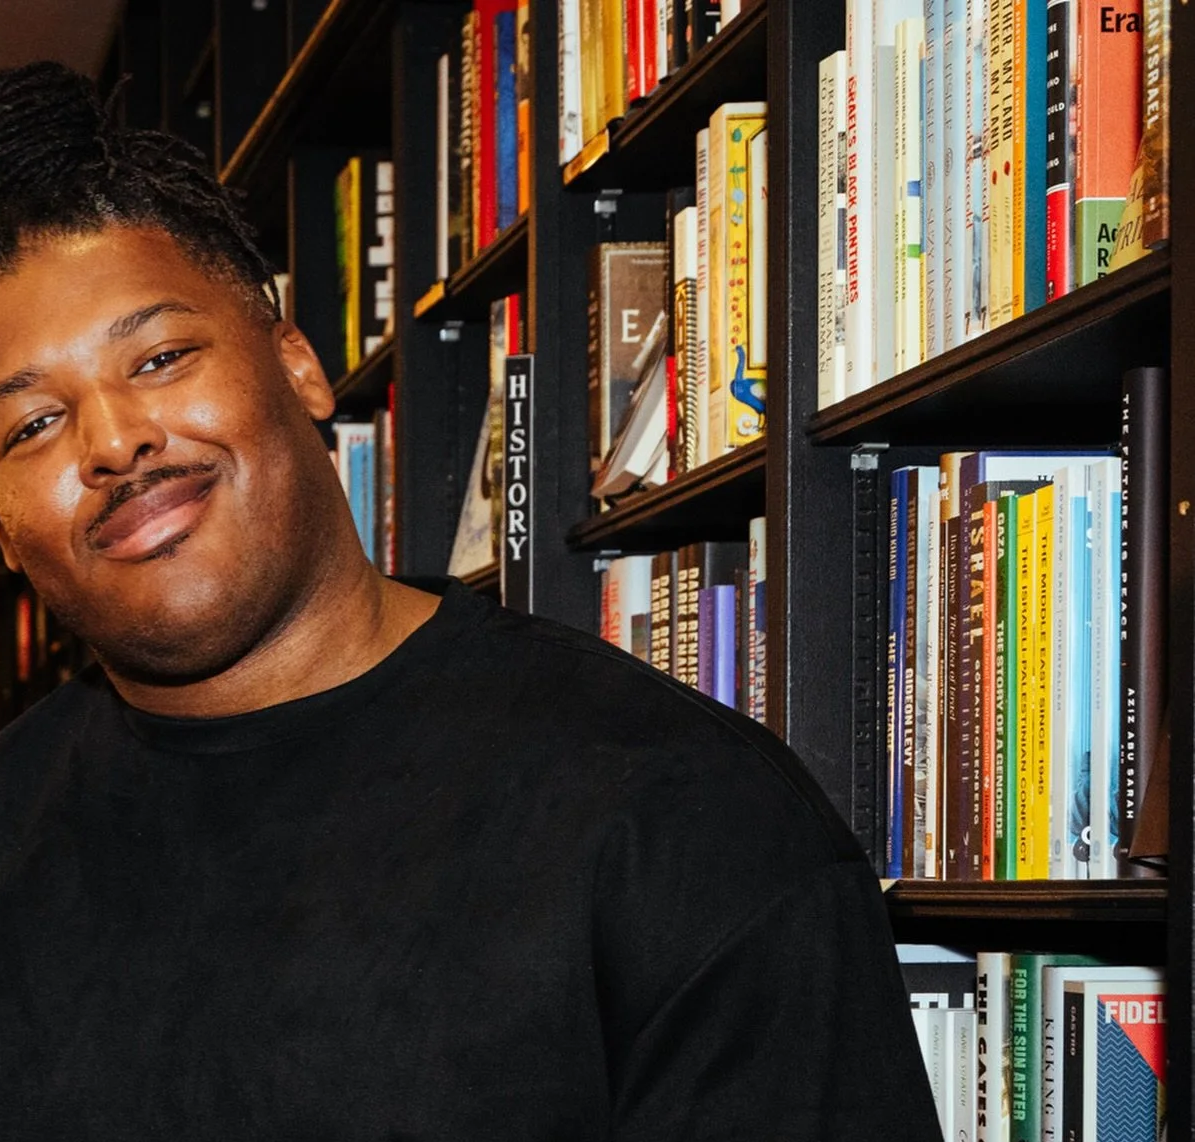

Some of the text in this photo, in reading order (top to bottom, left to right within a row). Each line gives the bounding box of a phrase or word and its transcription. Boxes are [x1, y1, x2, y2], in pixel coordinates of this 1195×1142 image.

[848, 76, 859, 149] ISRAEL'S
[990, 69, 999, 152] MY LAND
[1002, 58, 1012, 143] MY LAND
[1144, 45, 1160, 130] ISRAEL
[848, 152, 859, 208] BLACK
[848, 214, 859, 304] PANTHERS
[508, 374, 527, 561] HISTORY
[1121, 393, 1129, 641] THE FUTURE IS PEACE
[970, 508, 984, 645] ISRAEL
[996, 620, 1005, 652] THE
[1038, 533, 1047, 795] THE MIDDLE EAST SINCE 1945
[904, 668, 913, 766] GIDEON LEVY
[996, 655, 1005, 712] STORY
[996, 714, 1005, 736] OF
[1020, 544, 1028, 865] THE ISRAELI-PALESTINIAN CONFLICT
[996, 752, 1005, 838] GENOCIDE
[1126, 687, 1135, 820] AZIZ ABU SARAH
[977, 973, 987, 1026] THE
[1105, 1001, 1165, 1024] FIDEL
[977, 1036, 987, 1128] GATES
[1013, 968, 1026, 1121] FOR THE SUN AFTER
[1045, 1018, 1054, 1116] KICKING
